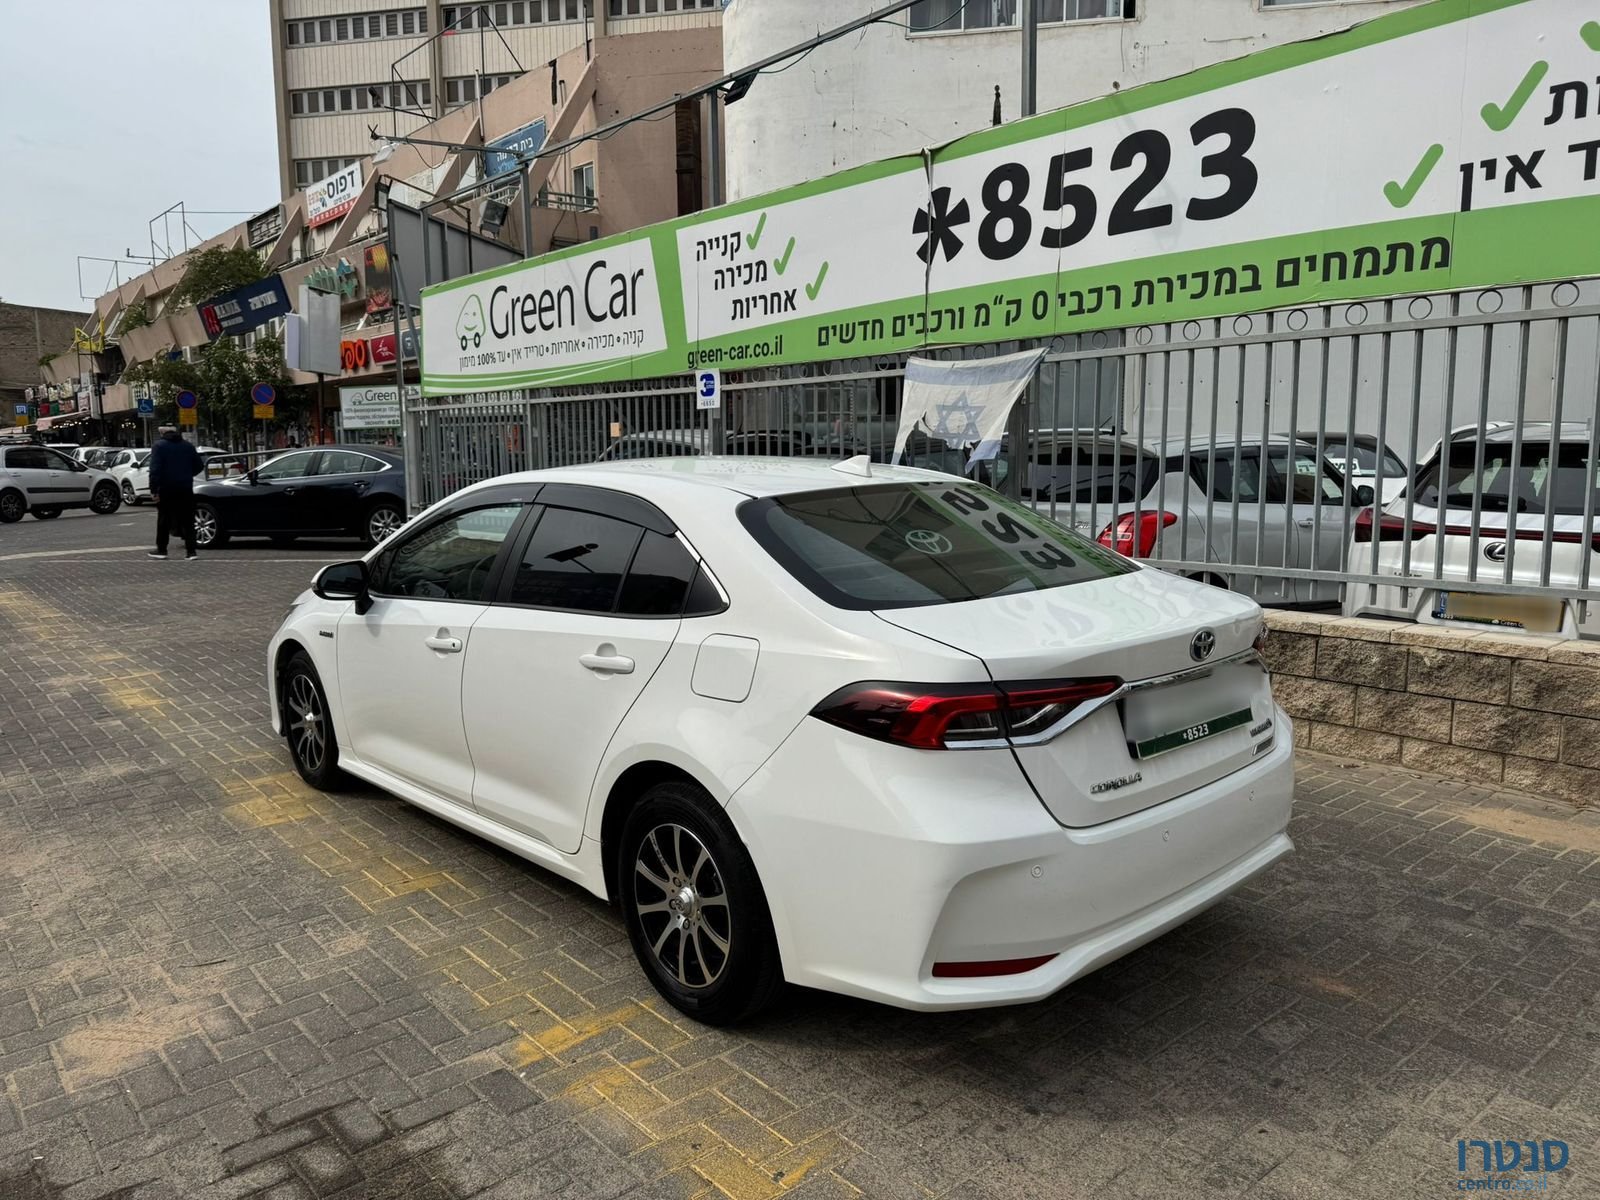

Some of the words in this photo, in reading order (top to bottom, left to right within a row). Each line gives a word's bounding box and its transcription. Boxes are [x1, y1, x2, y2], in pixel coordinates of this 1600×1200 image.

[327, 170, 355, 199] דפוס
[1460, 149, 1546, 213] אין
[697, 231, 741, 262] קנייה
[714, 260, 768, 291] מכירה
[1276, 237, 1450, 288] מתמחים
[490, 285, 575, 340] Green
[584, 260, 644, 323] Car
[1058, 284, 1121, 316] רכבי
[1132, 264, 1262, 307] במכירת
[731, 288, 797, 321] אחריות
[1032, 290, 1049, 320] 0
[817, 318, 884, 347] חדשים
[892, 307, 965, 338] ורכבים
[524, 344, 544, 359] טרייד
[551, 339, 580, 355] אחריות
[588, 333, 614, 350] מכירה
[622, 329, 644, 348] קניה
[688, 334, 783, 368] green-car.co.il
[477, 352, 496, 366] 100%
[511, 348, 522, 364] אין
[365, 389, 397, 401] Green
